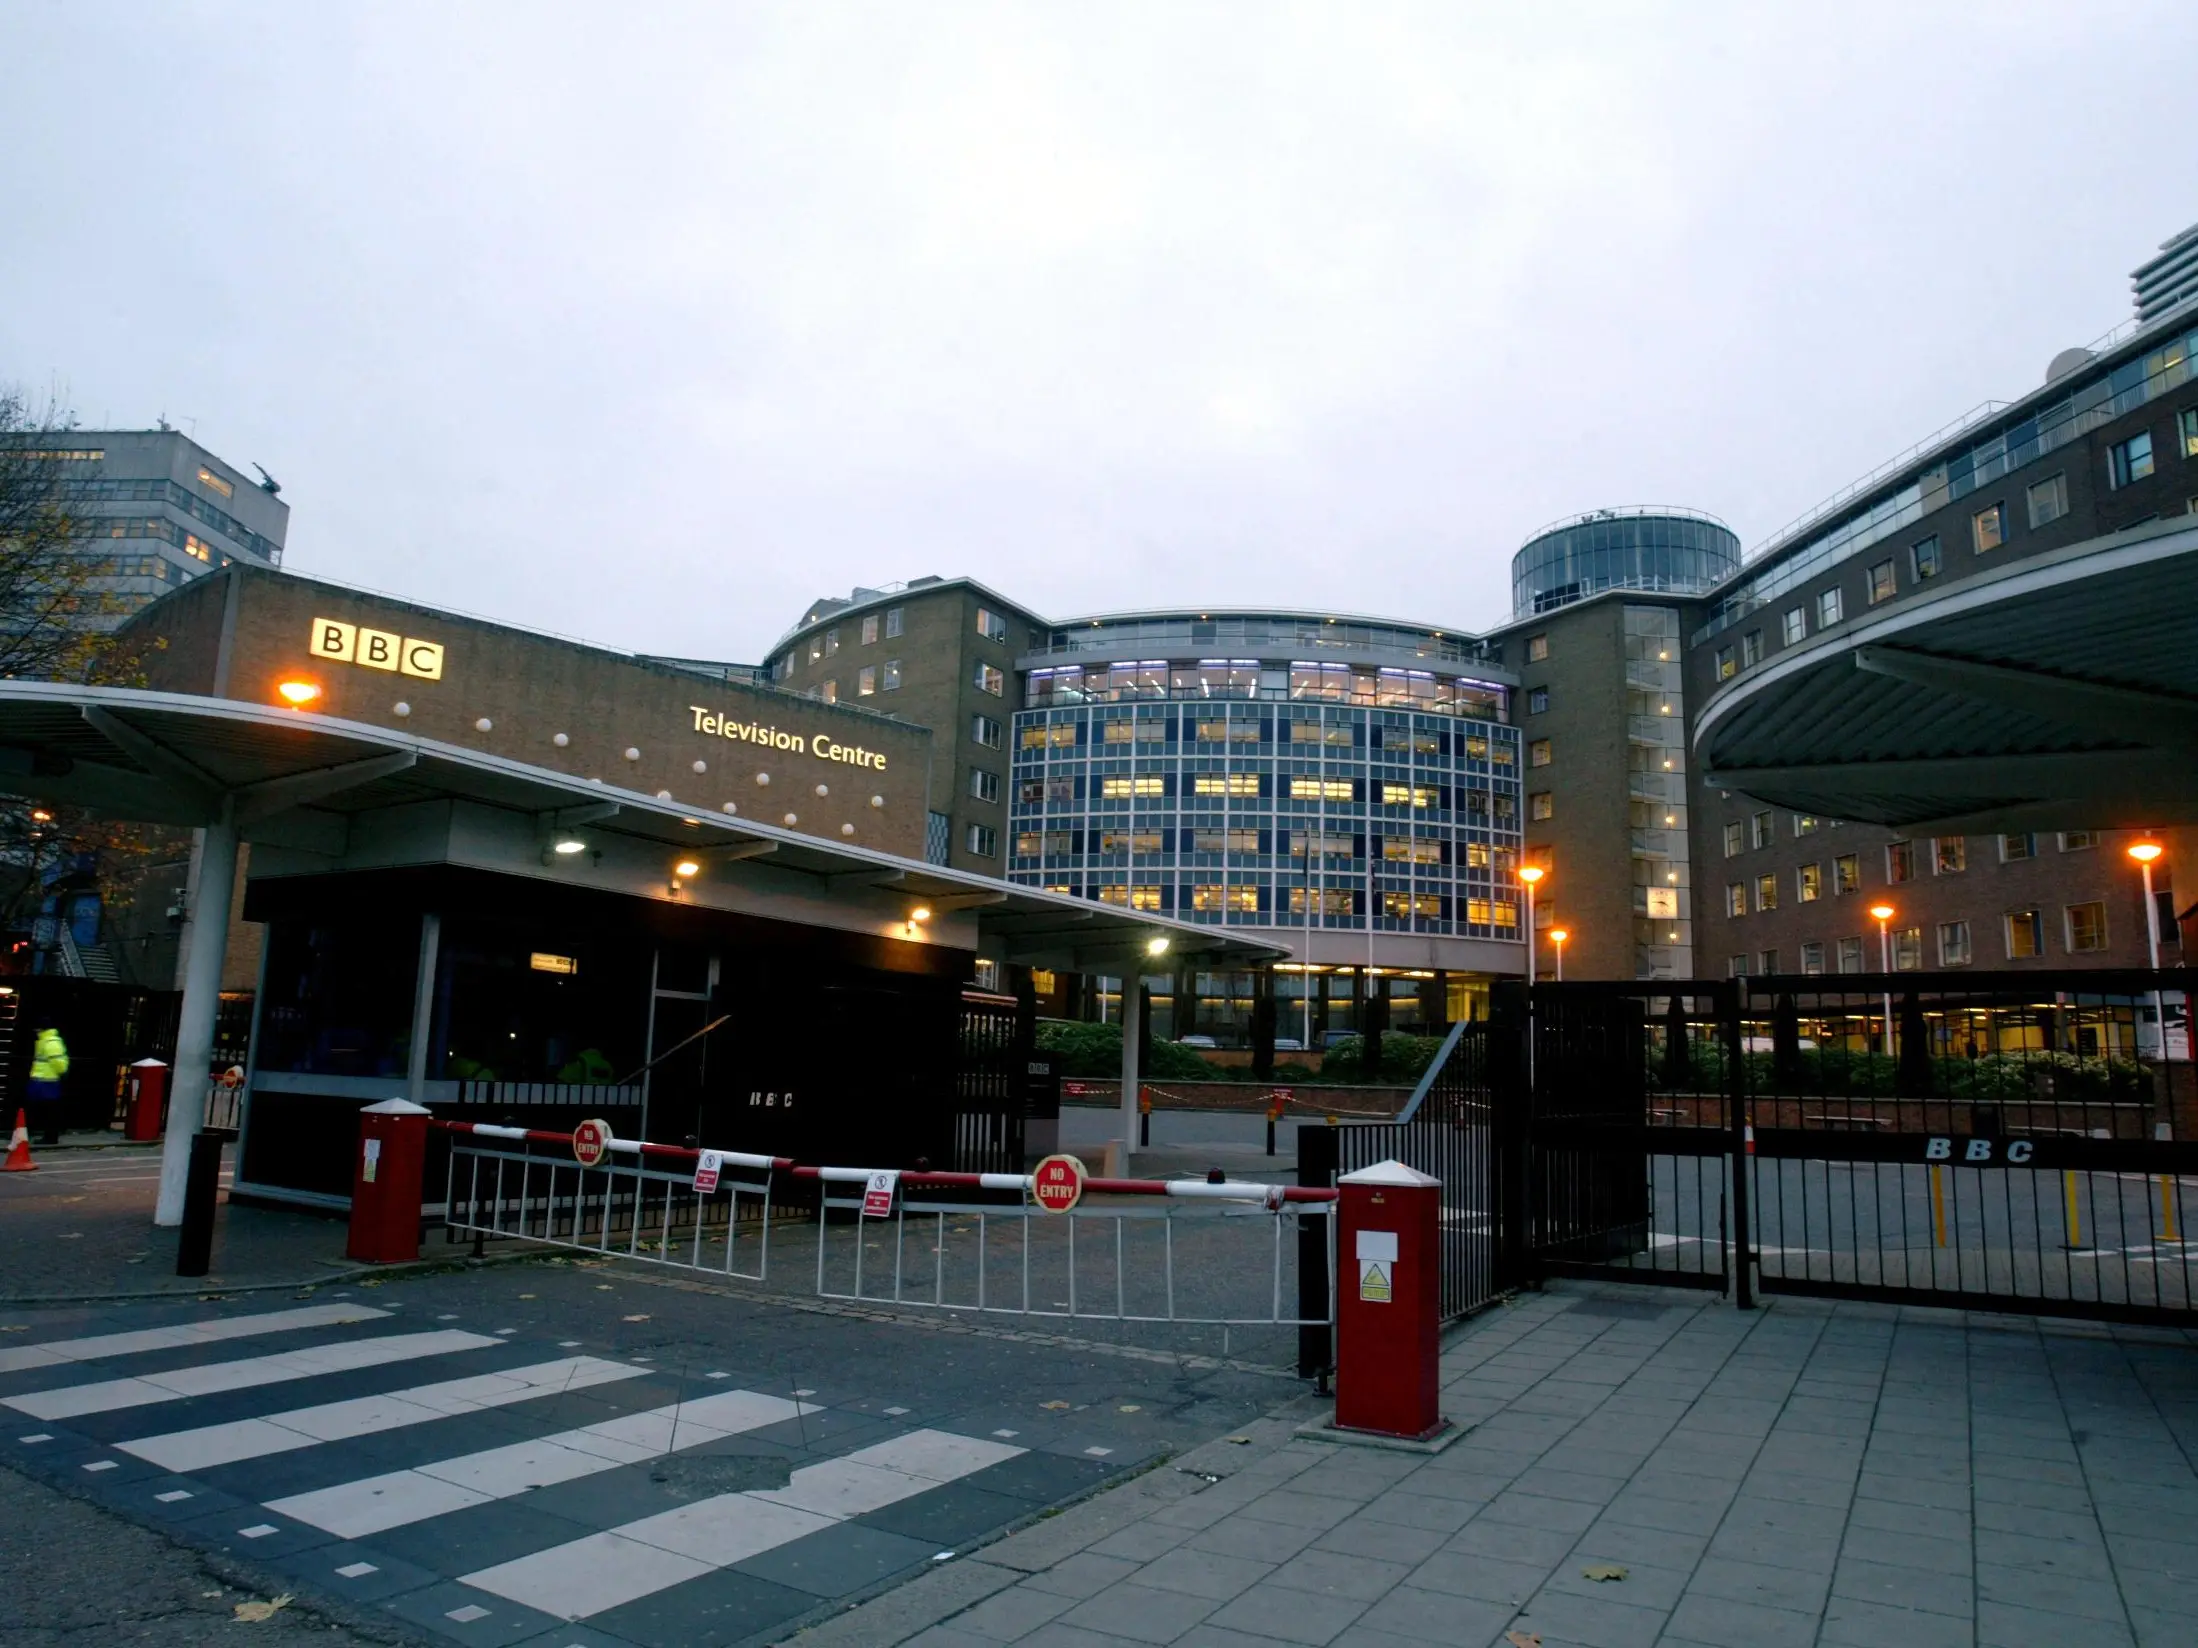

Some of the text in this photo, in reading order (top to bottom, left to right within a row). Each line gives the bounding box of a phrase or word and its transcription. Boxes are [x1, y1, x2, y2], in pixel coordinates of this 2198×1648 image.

[322, 624, 436, 673] BBC
[689, 705, 887, 771] Television Centre
[577, 1142, 600, 1156] ENTRY
[1925, 1137, 2034, 1164] BBC
[1050, 1167, 1065, 1181] NO
[1040, 1183, 1074, 1199] ENTRY
